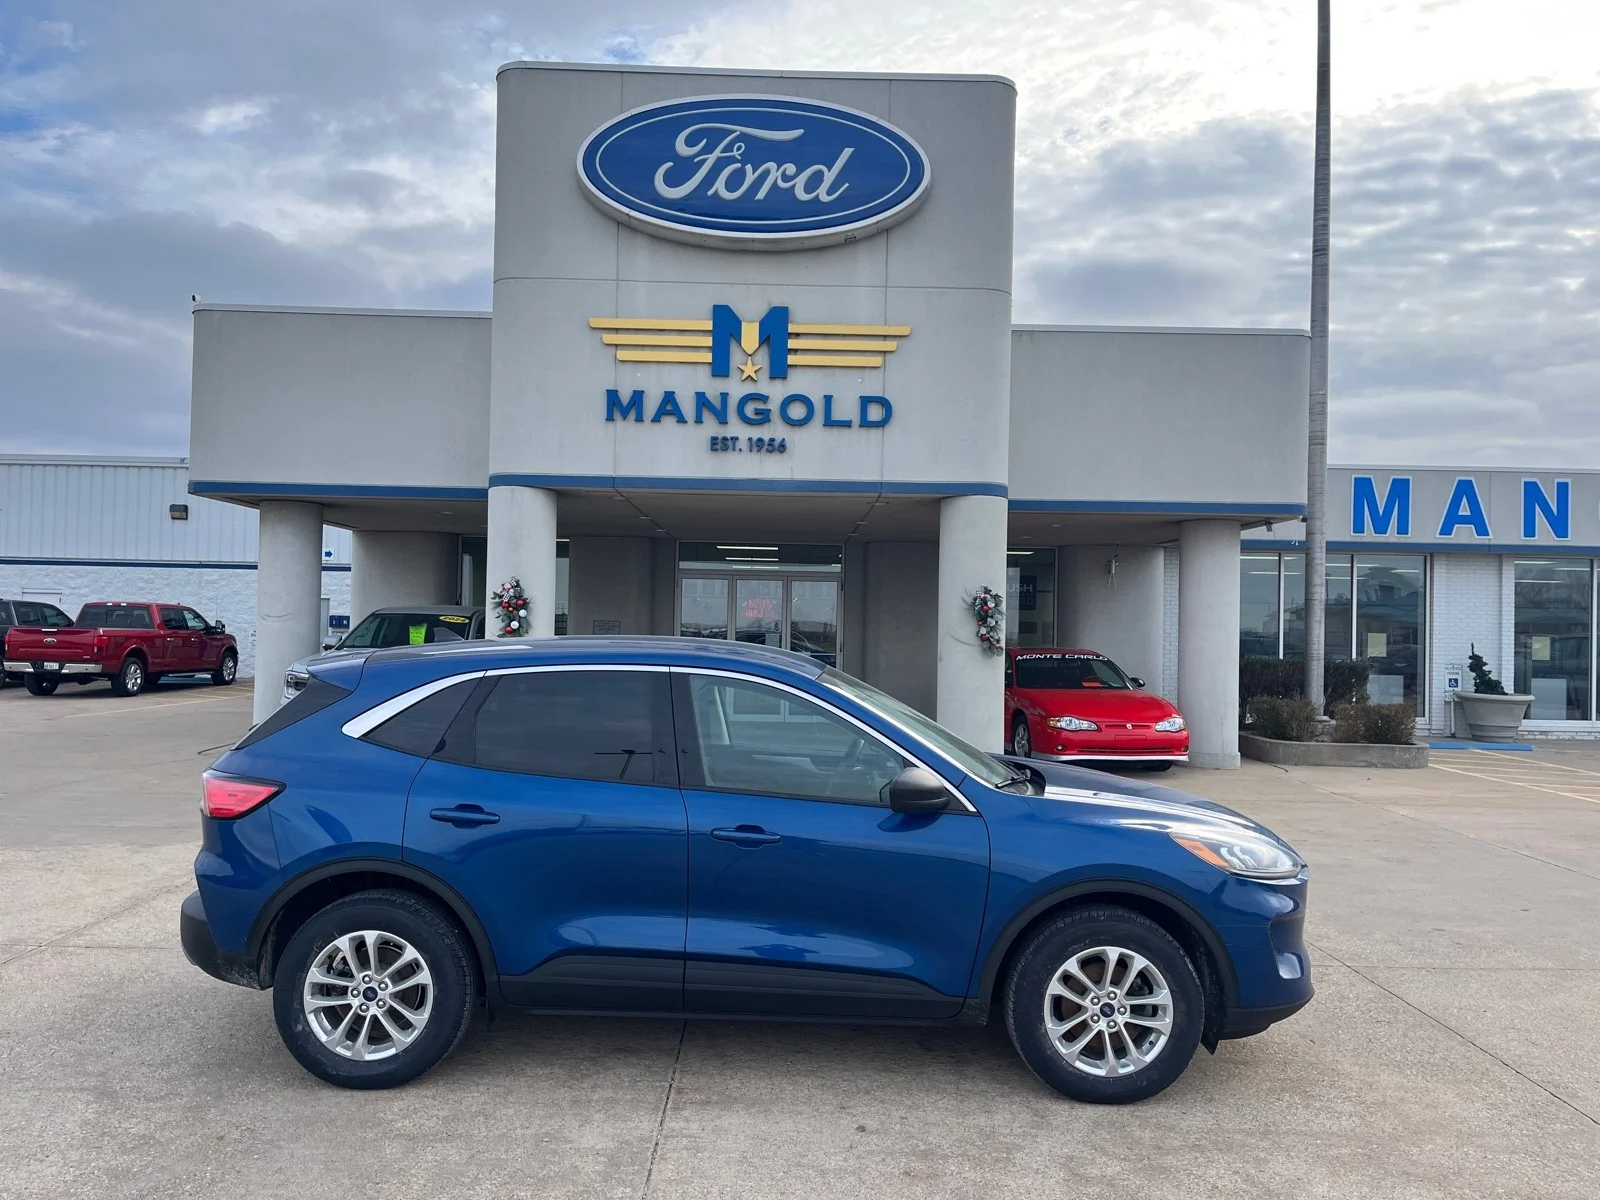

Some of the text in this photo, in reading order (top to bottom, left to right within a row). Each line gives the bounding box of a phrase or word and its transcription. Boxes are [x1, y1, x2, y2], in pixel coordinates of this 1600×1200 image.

[654, 122, 856, 203] Ford
[711, 304, 790, 379] M
[605, 388, 894, 428] MANGOLD
[709, 435, 788, 454] EST. 1956
[1350, 474, 1600, 541] MAN
[1006, 584, 1033, 592] USH
[1016, 653, 1062, 661] MONTE
